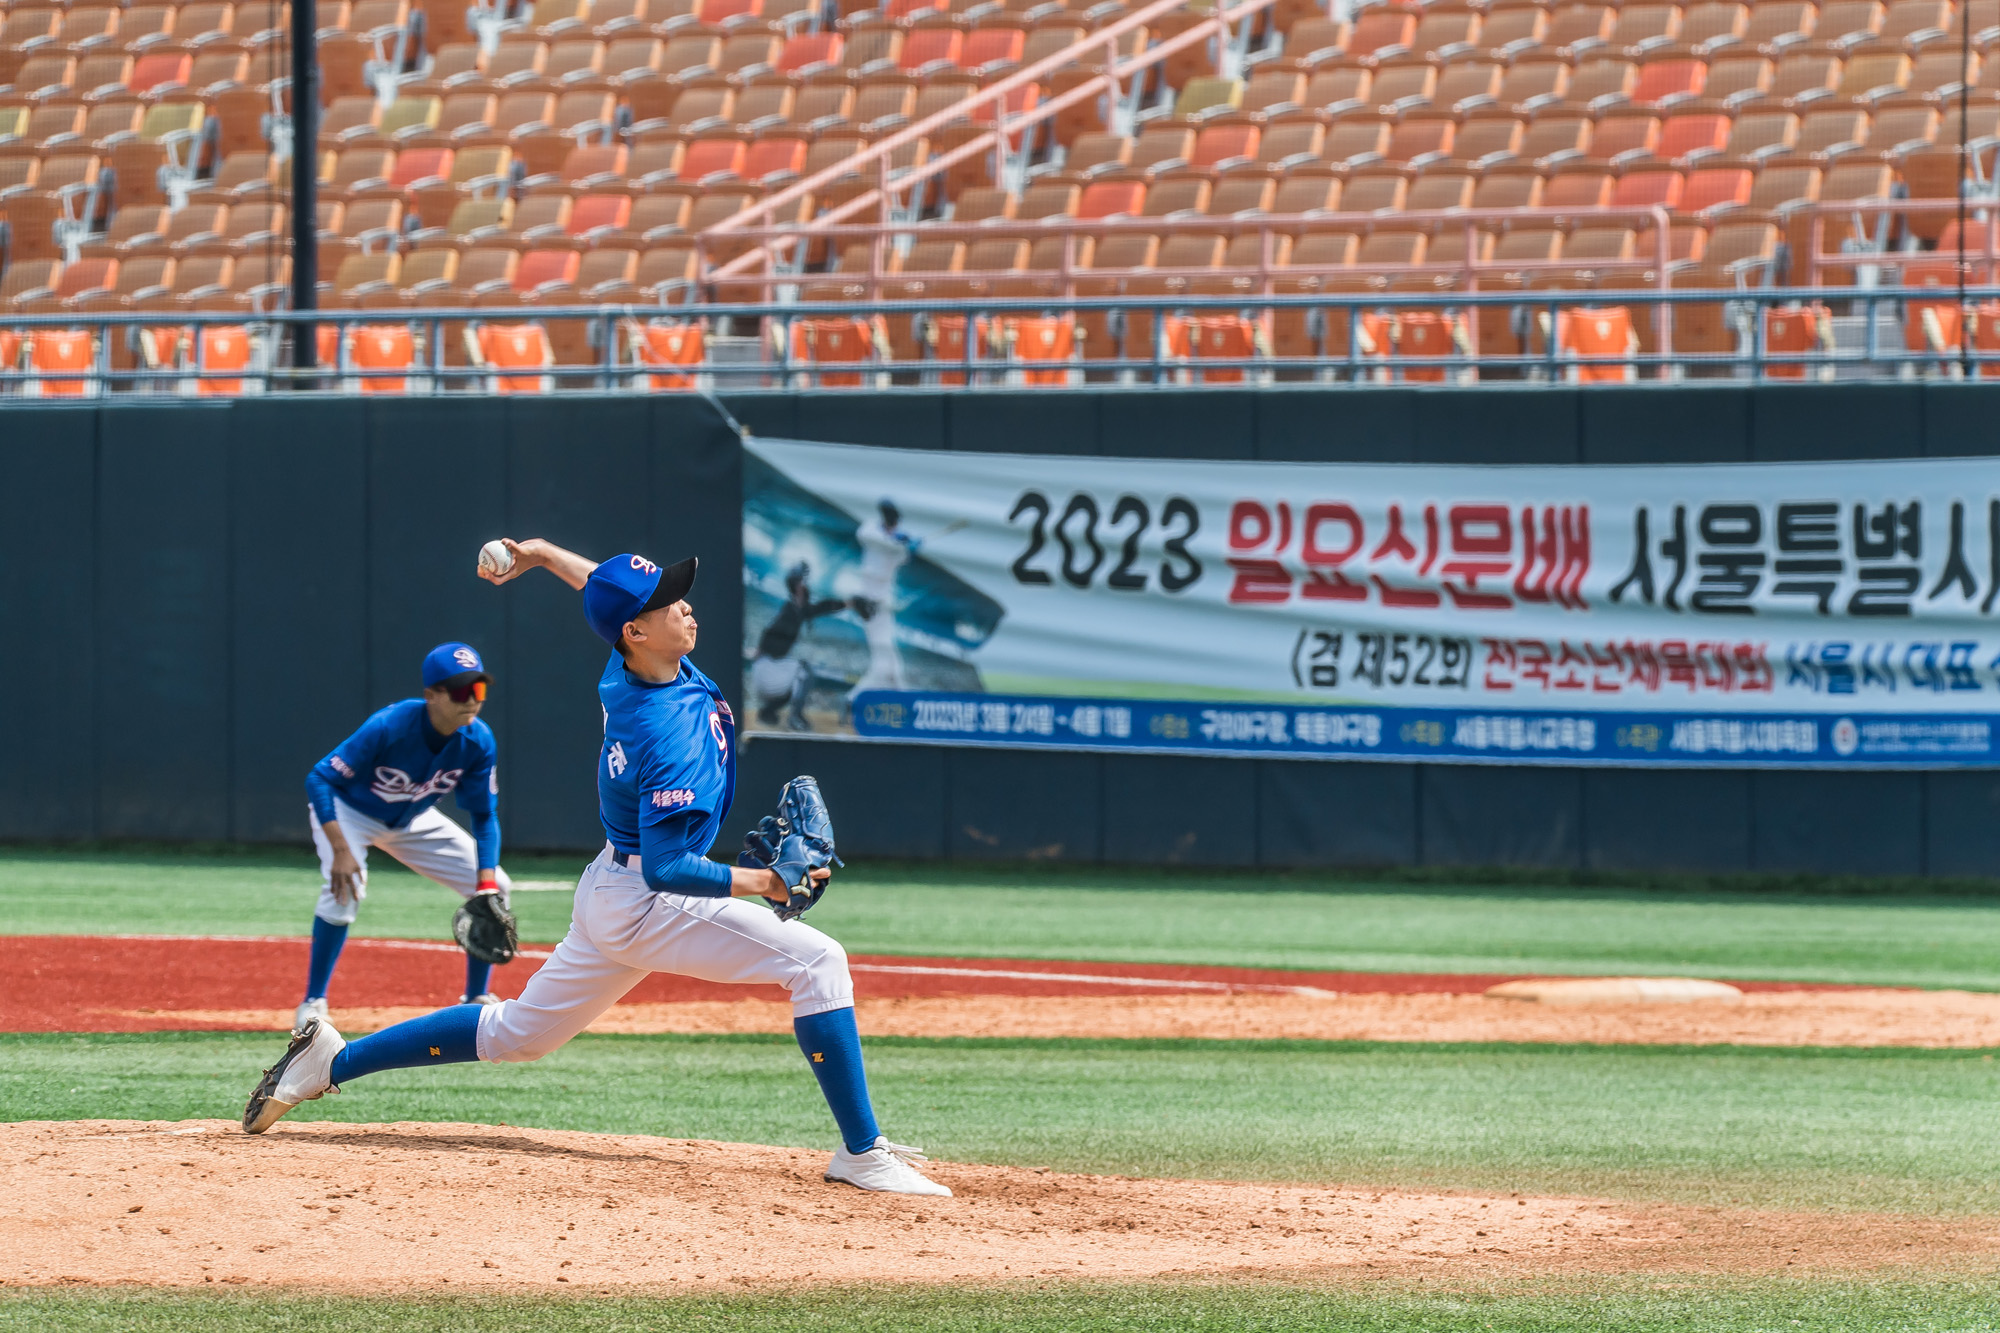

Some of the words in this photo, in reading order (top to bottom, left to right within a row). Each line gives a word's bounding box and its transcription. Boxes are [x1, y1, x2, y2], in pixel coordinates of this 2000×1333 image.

[1008, 488, 1203, 592] 2023
[1226, 498, 1592, 611] 일요신문배
[1607, 500, 2000, 617] 서울특별시
[1292, 628, 1343, 688] (겸
[1352, 628, 1474, 690] 제52회
[1479, 637, 1774, 693] 전국소년체육대회
[1785, 641, 1898, 694] 서울시
[1902, 640, 1983, 694] 대표
[913, 700, 979, 733] 2023년
